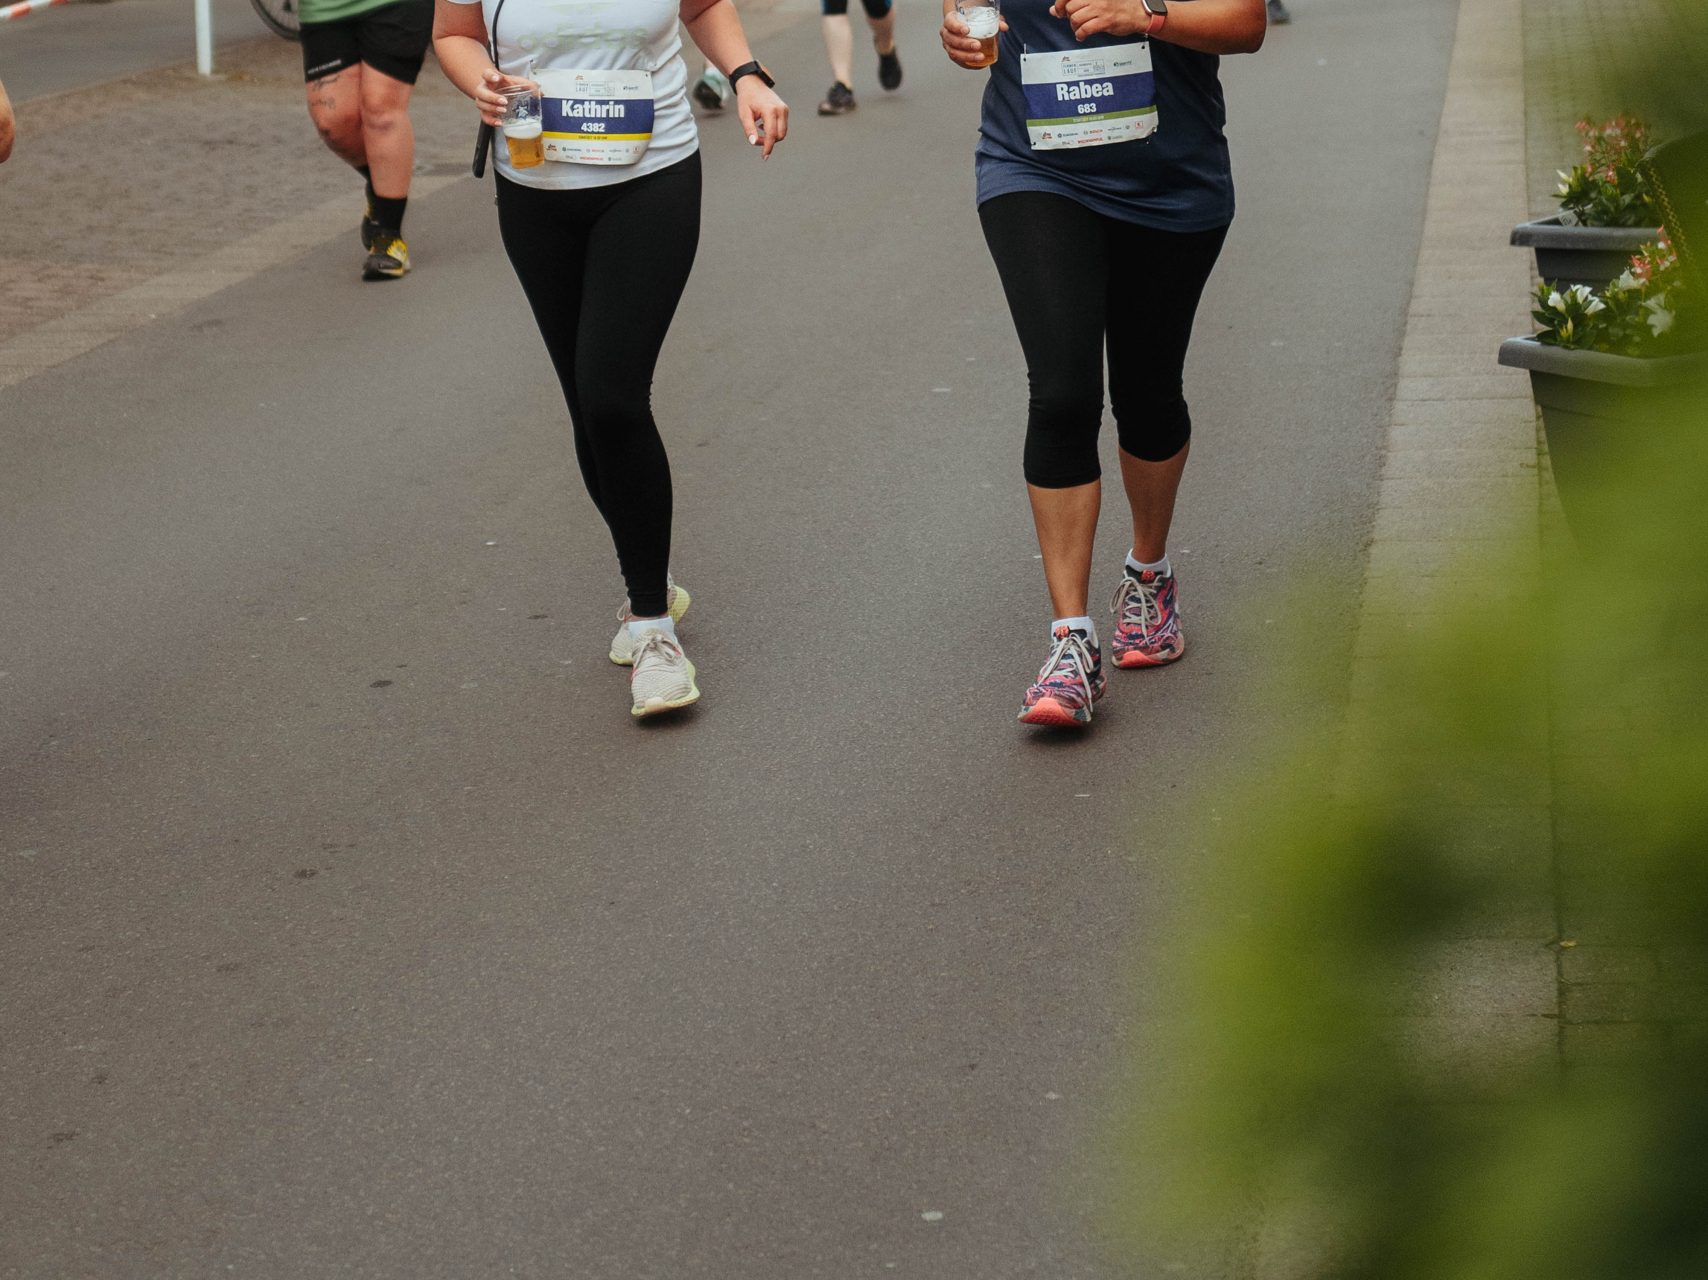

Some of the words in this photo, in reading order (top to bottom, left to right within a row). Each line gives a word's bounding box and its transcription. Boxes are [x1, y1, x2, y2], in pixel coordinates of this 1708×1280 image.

[1055, 81, 1115, 101] Rabea
[561, 100, 625, 118] Kathrin
[1077, 103, 1097, 114] 683
[580, 122, 606, 133] 4382
